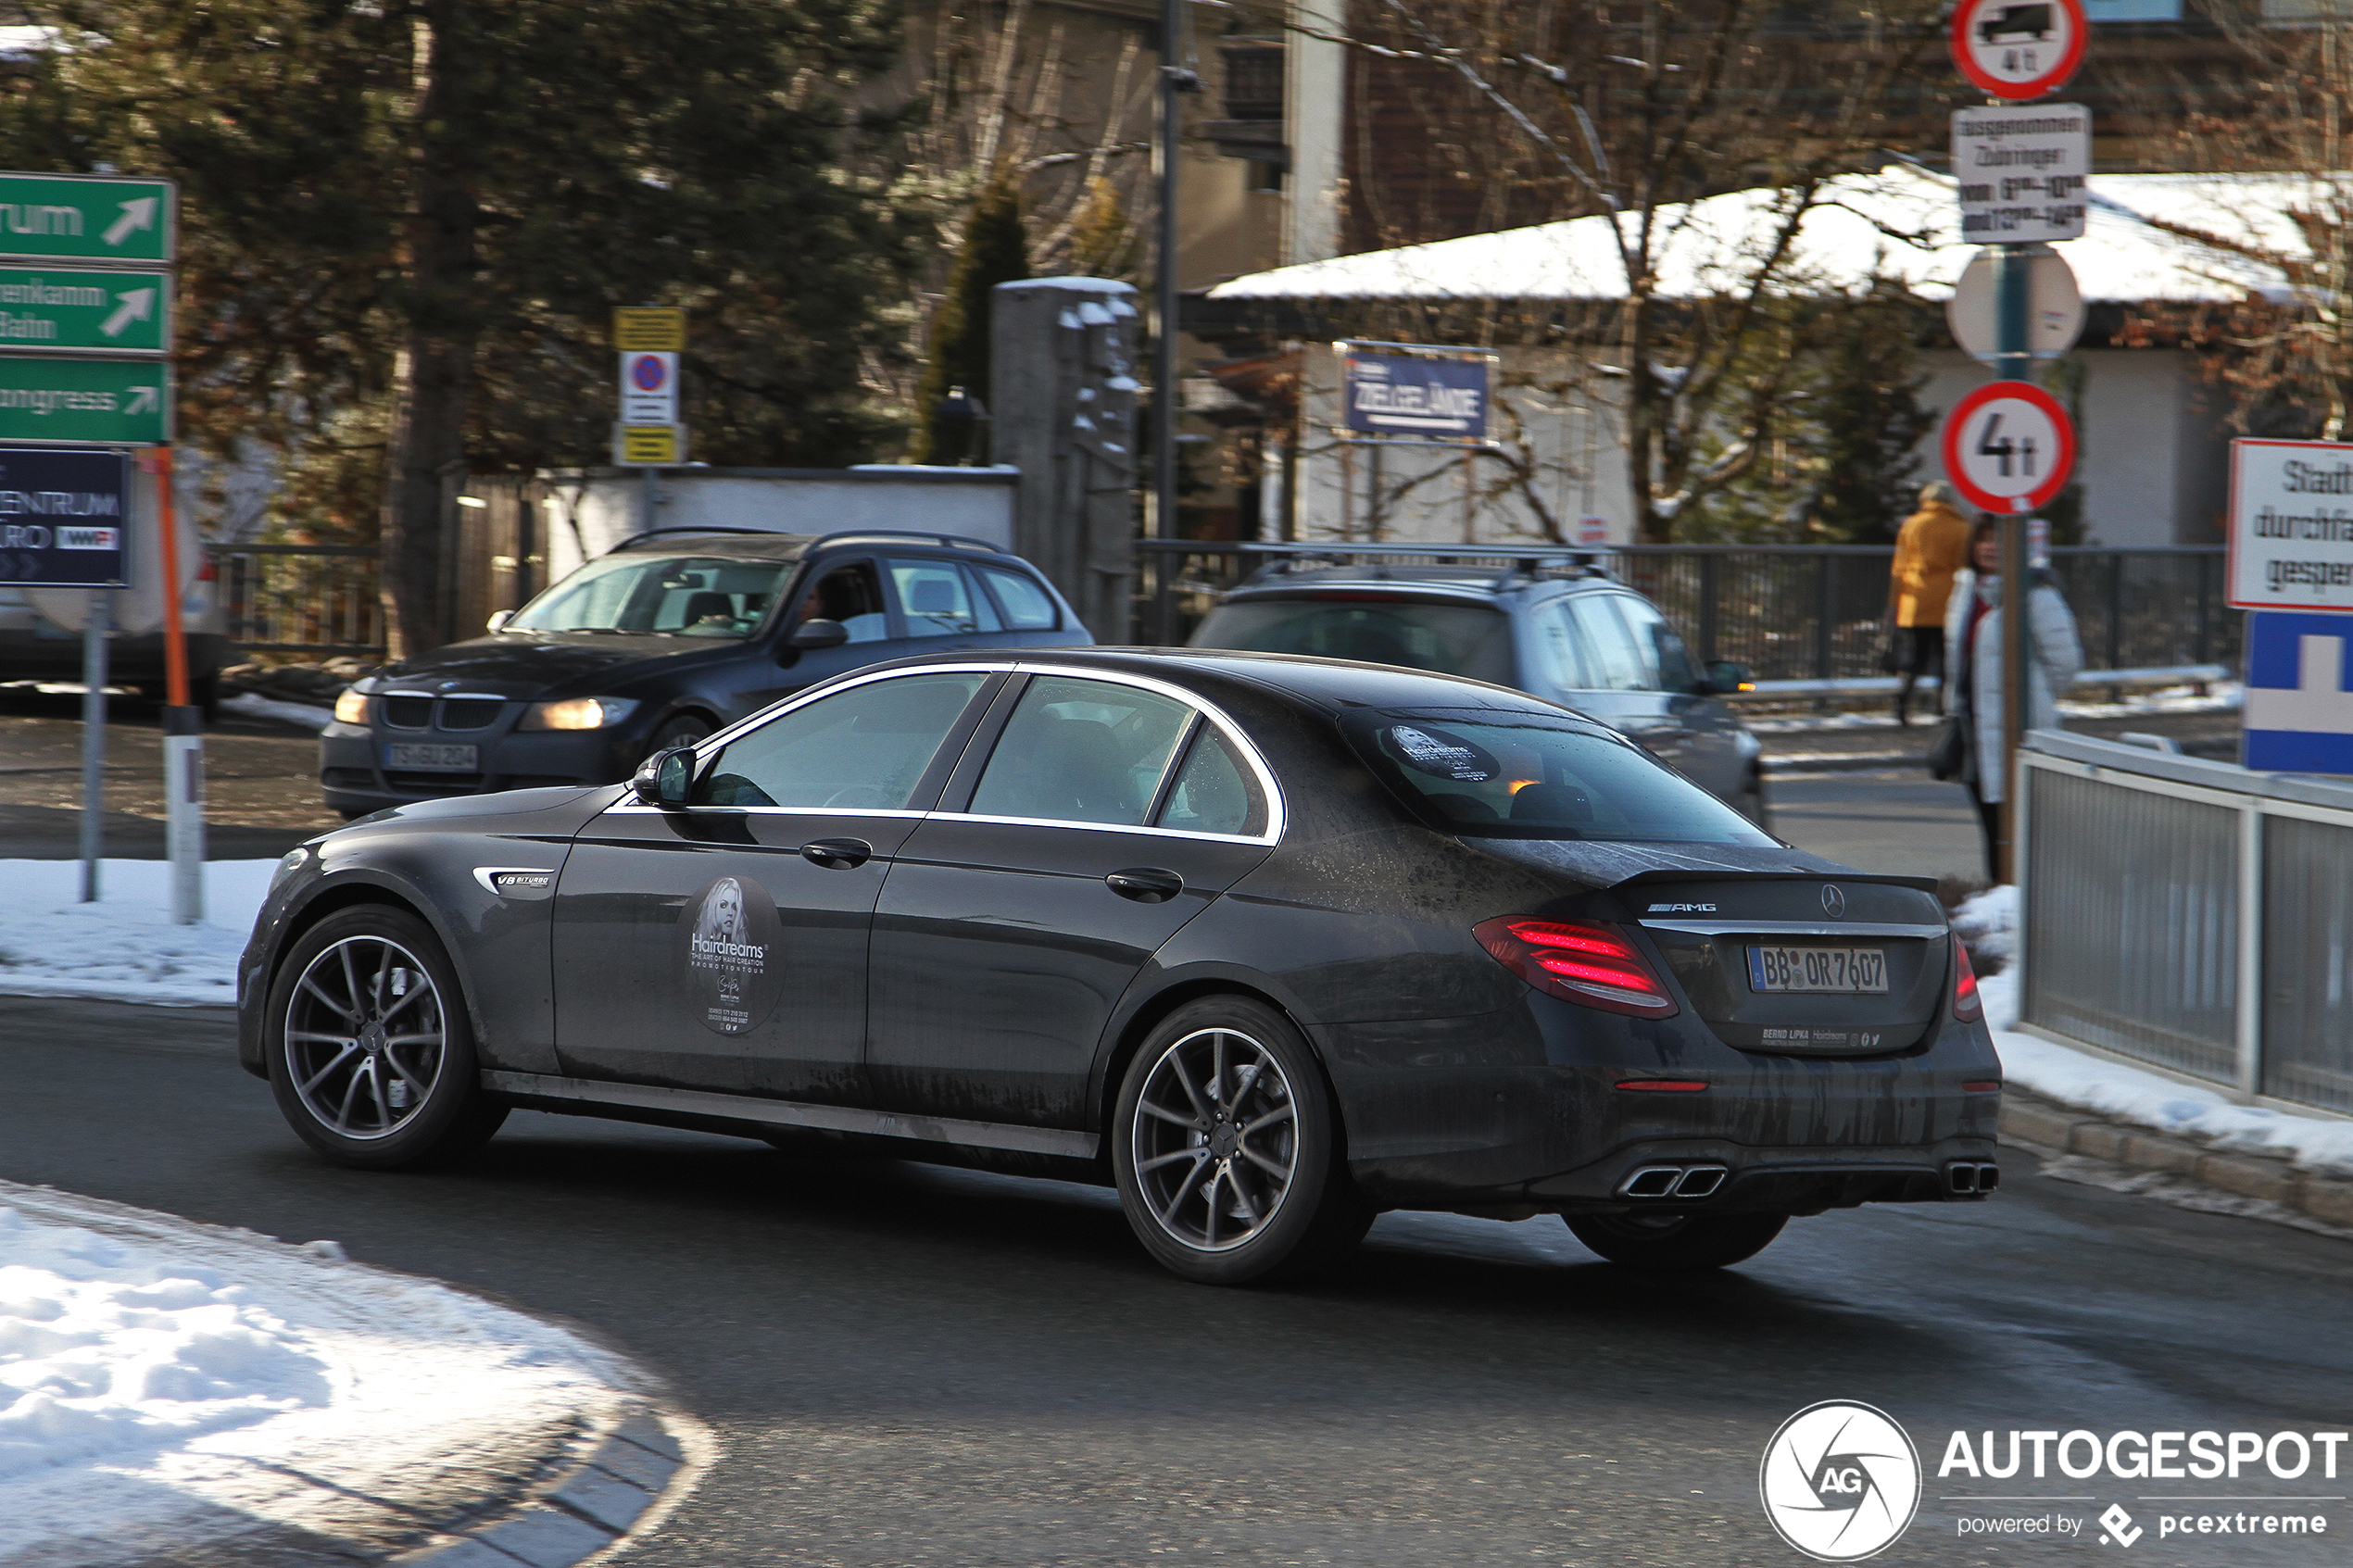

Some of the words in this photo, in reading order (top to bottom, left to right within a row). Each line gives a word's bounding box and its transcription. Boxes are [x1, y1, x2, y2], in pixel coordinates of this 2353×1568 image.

[497, 876, 516, 885] V8
[1671, 903, 1717, 912] AMG
[691, 933, 763, 959] Hairdreams
[736, 958, 764, 967] CREATION
